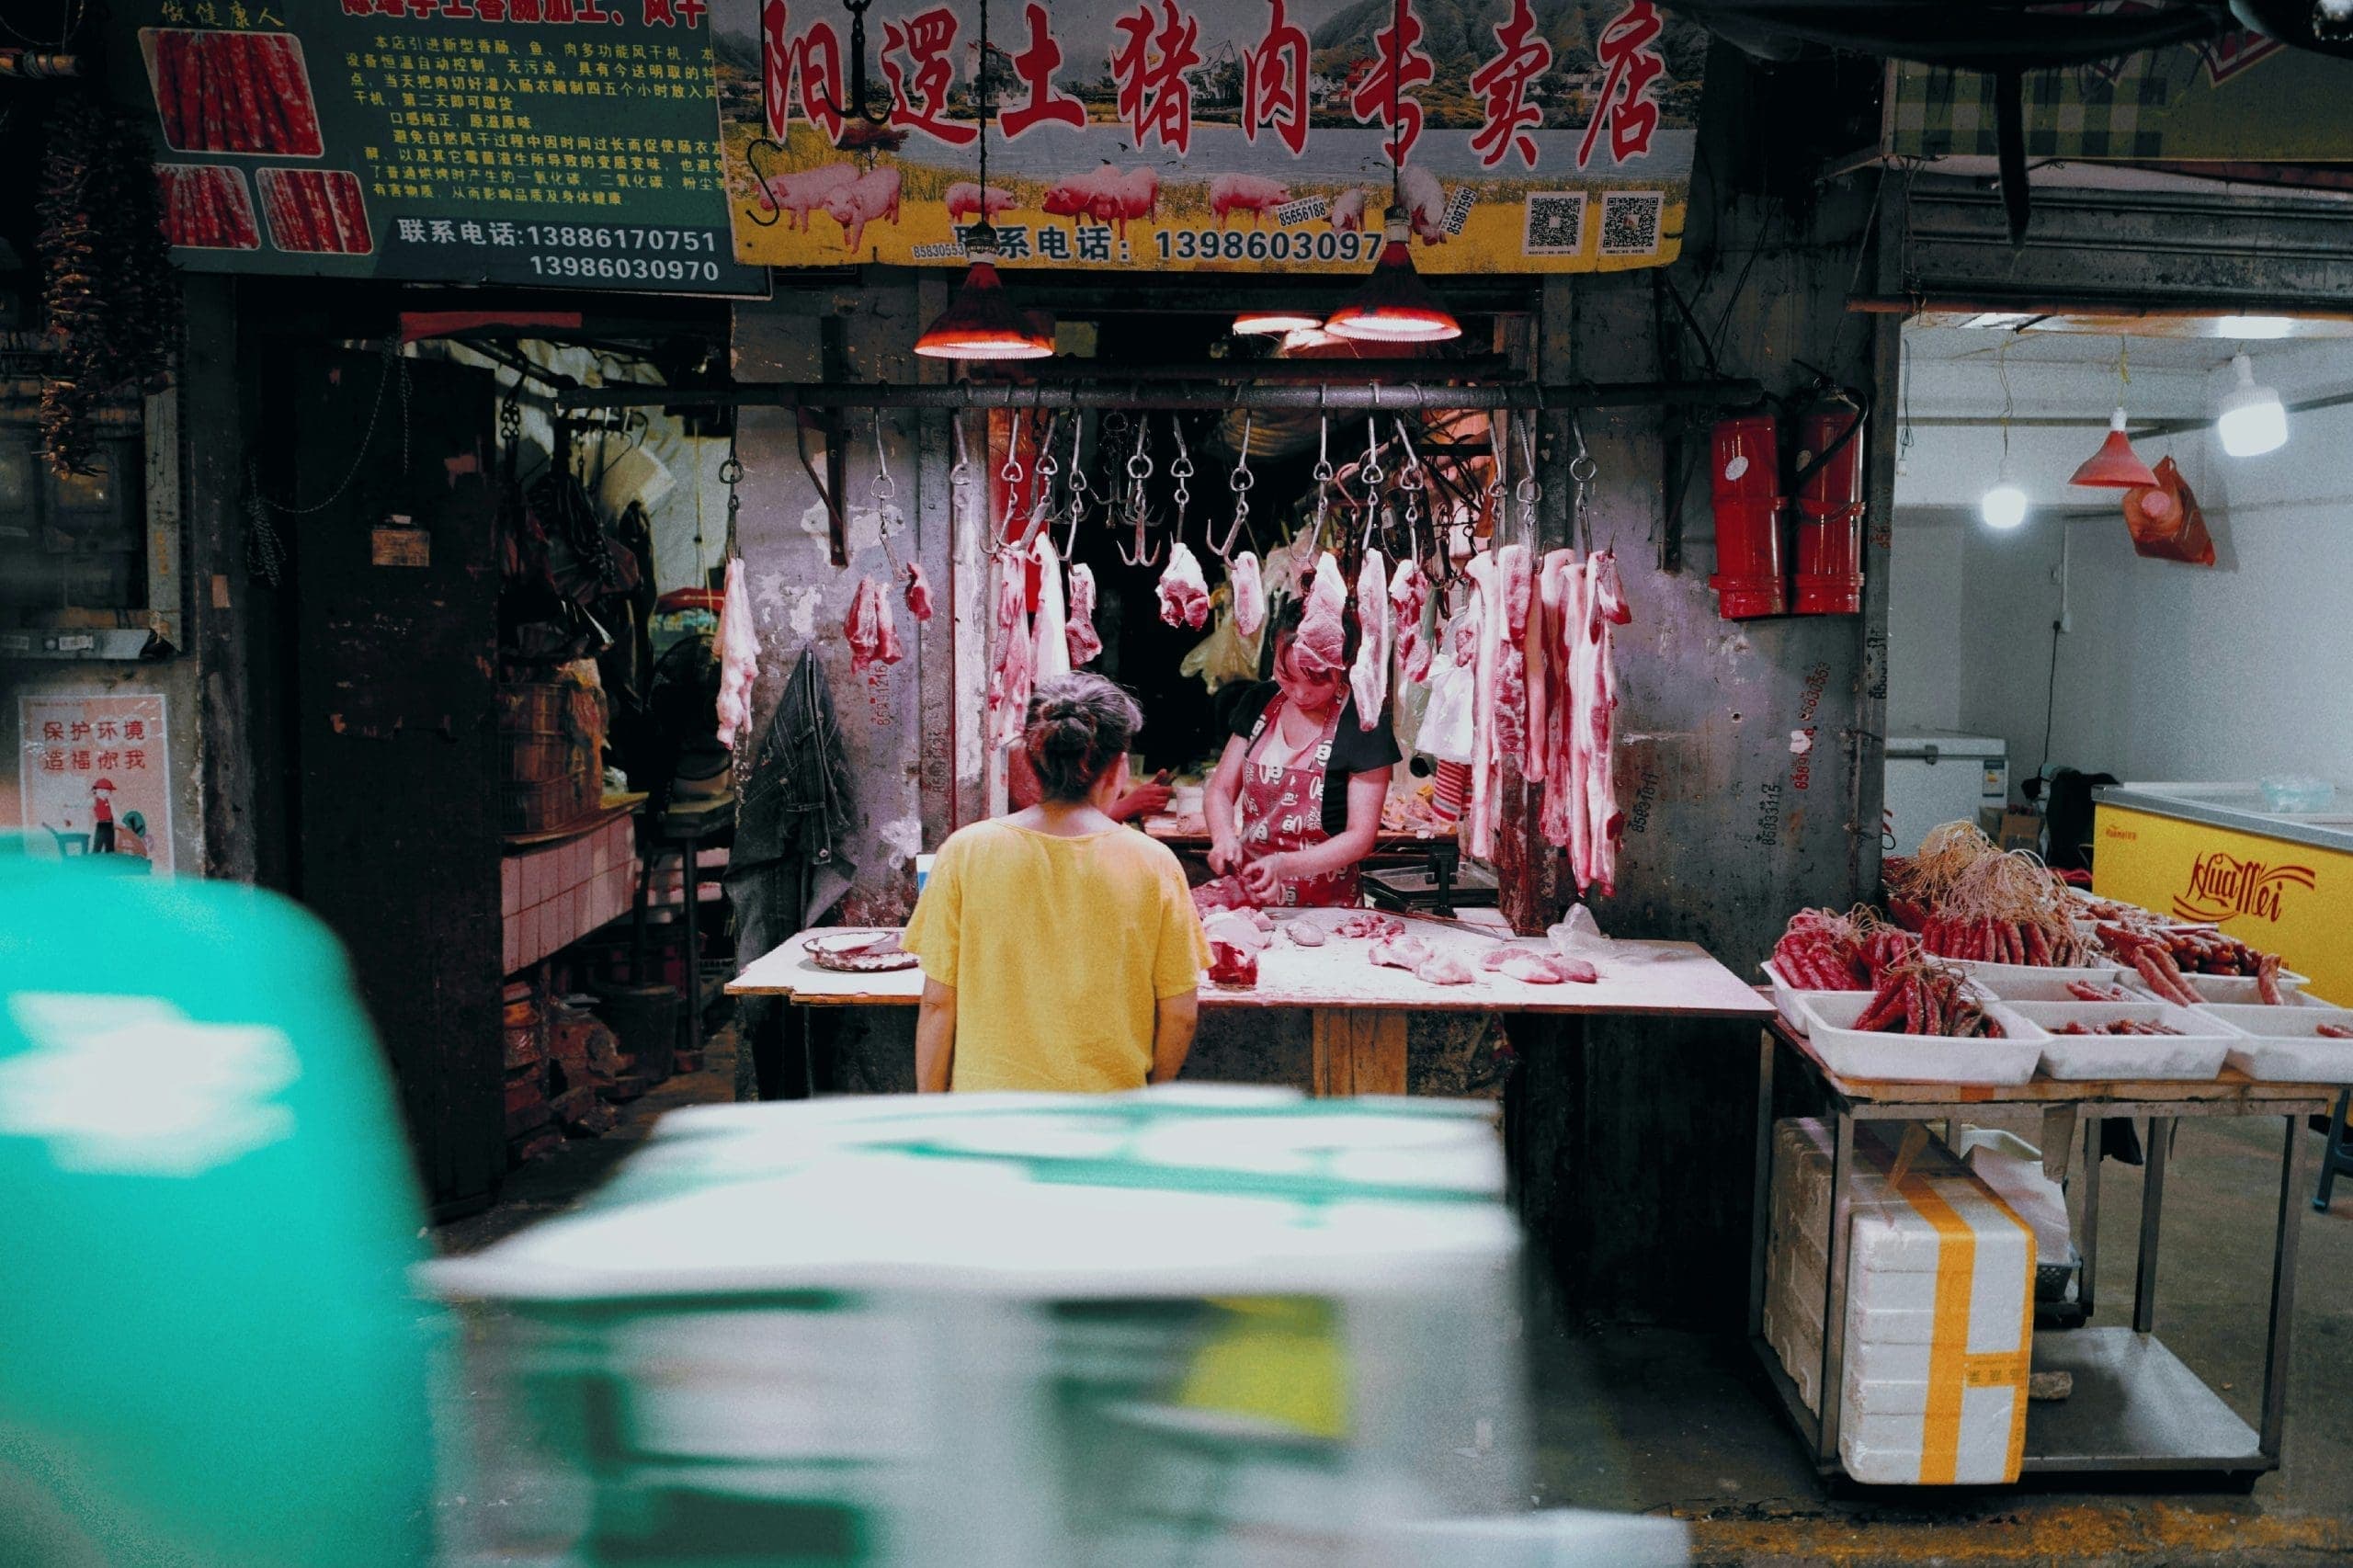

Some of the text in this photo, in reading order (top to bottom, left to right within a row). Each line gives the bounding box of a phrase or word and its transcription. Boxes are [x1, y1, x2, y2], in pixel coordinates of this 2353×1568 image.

[1279, 201, 1326, 227] 85656188
[1447, 189, 1476, 235] 85887599
[1155, 231, 1385, 261] 1398603097
[530, 255, 719, 281] 13986030970
[43, 721, 145, 742] 保护环境
[43, 749, 146, 770] 造福你我
